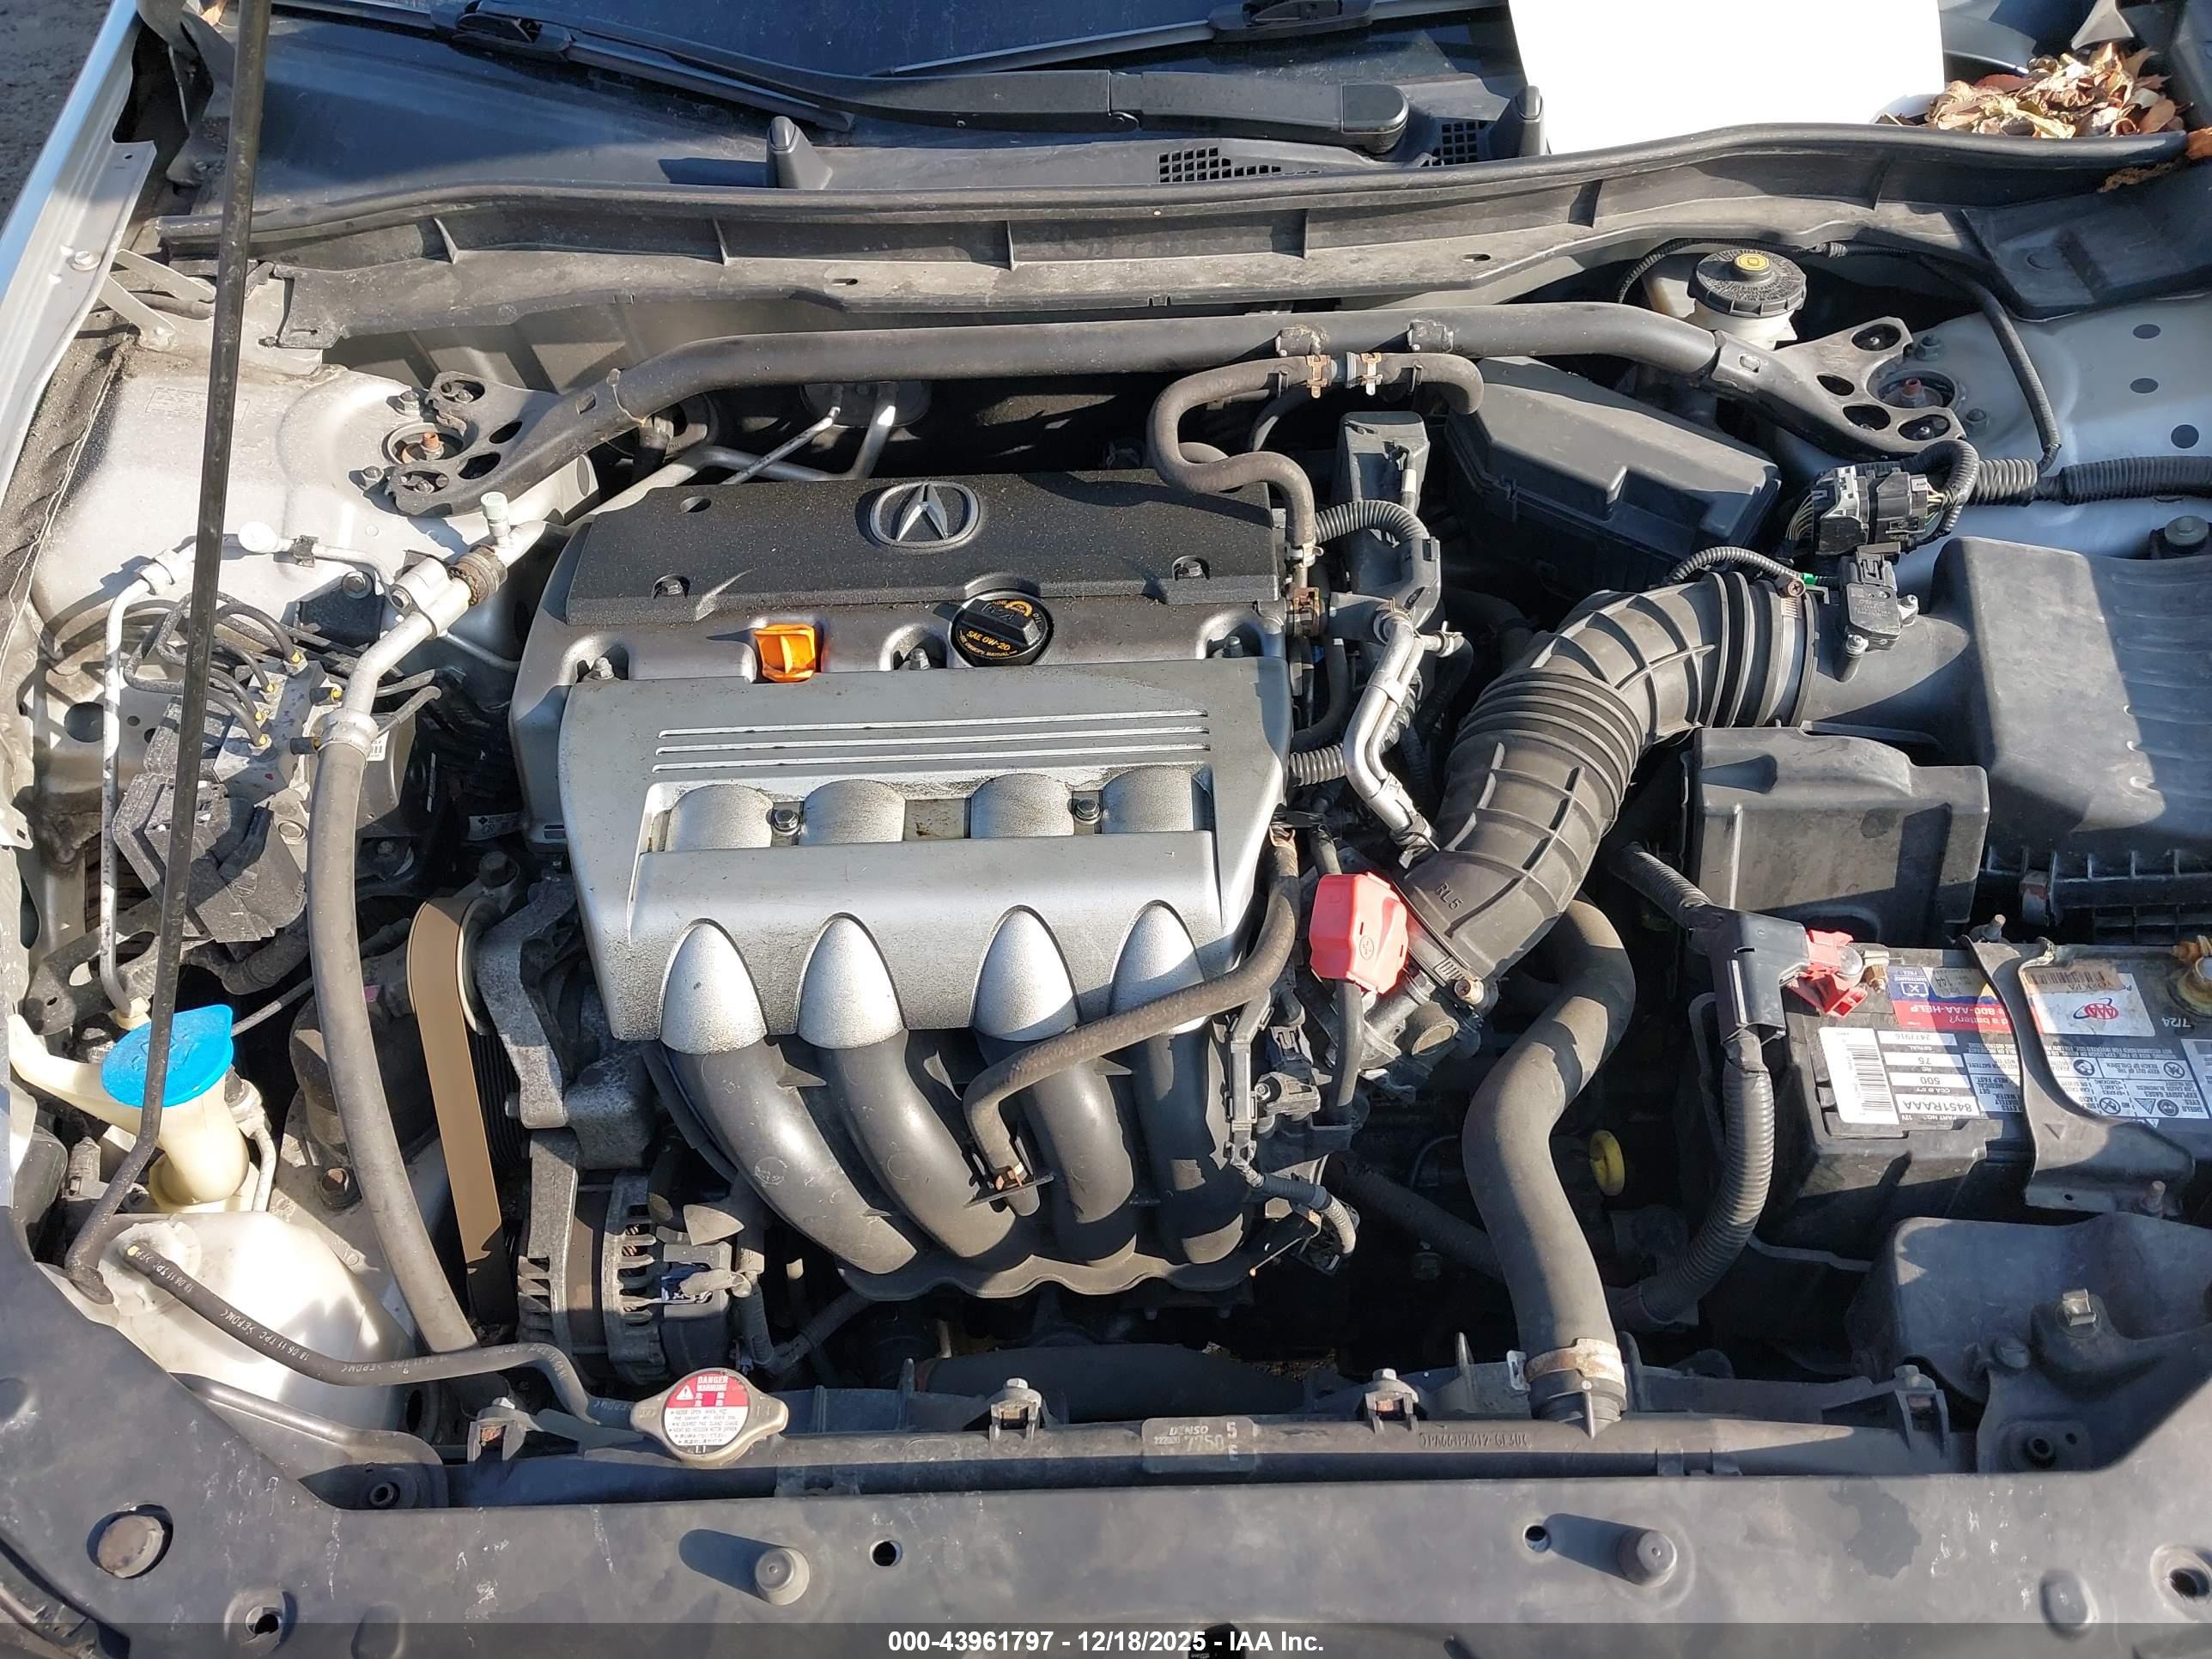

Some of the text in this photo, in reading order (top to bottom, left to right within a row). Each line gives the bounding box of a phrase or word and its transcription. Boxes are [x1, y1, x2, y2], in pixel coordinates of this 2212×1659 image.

[966, 630, 1011, 652] SAE 0W-20
[2087, 1005, 2116, 1018] AAA
[1949, 1015, 1990, 1024] battery?
[1903, 1101, 1972, 1112] 8451RAAA
[1169, 1425, 1209, 1436] DENSO
[1226, 1421, 1237, 1440] 5
